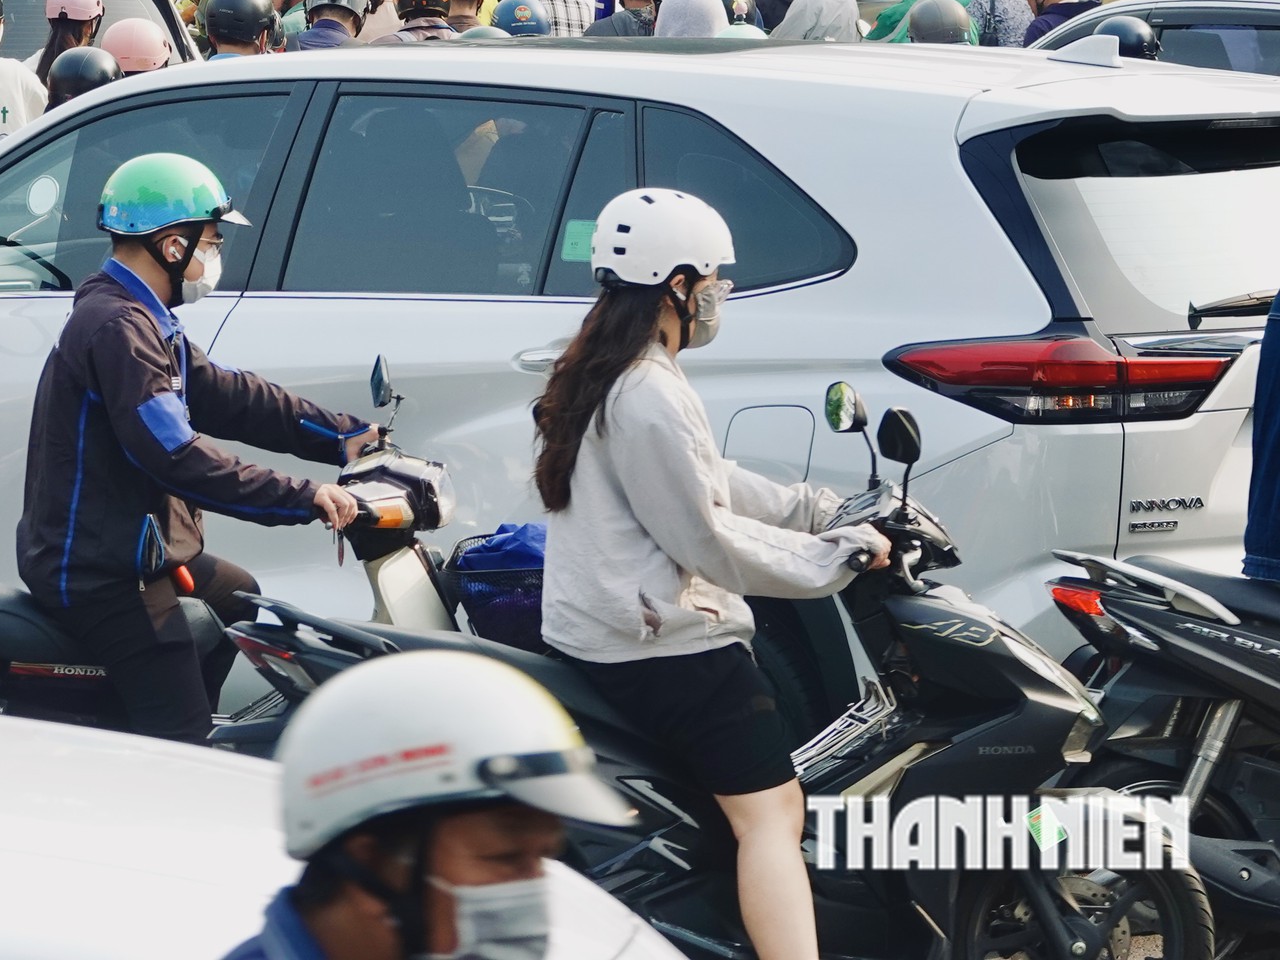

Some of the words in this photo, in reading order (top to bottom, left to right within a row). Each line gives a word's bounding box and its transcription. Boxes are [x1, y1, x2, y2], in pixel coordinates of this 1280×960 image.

[1130, 496, 1205, 513] INNOVA
[53, 666, 107, 676] HONDA
[977, 745, 1037, 755] HONDA
